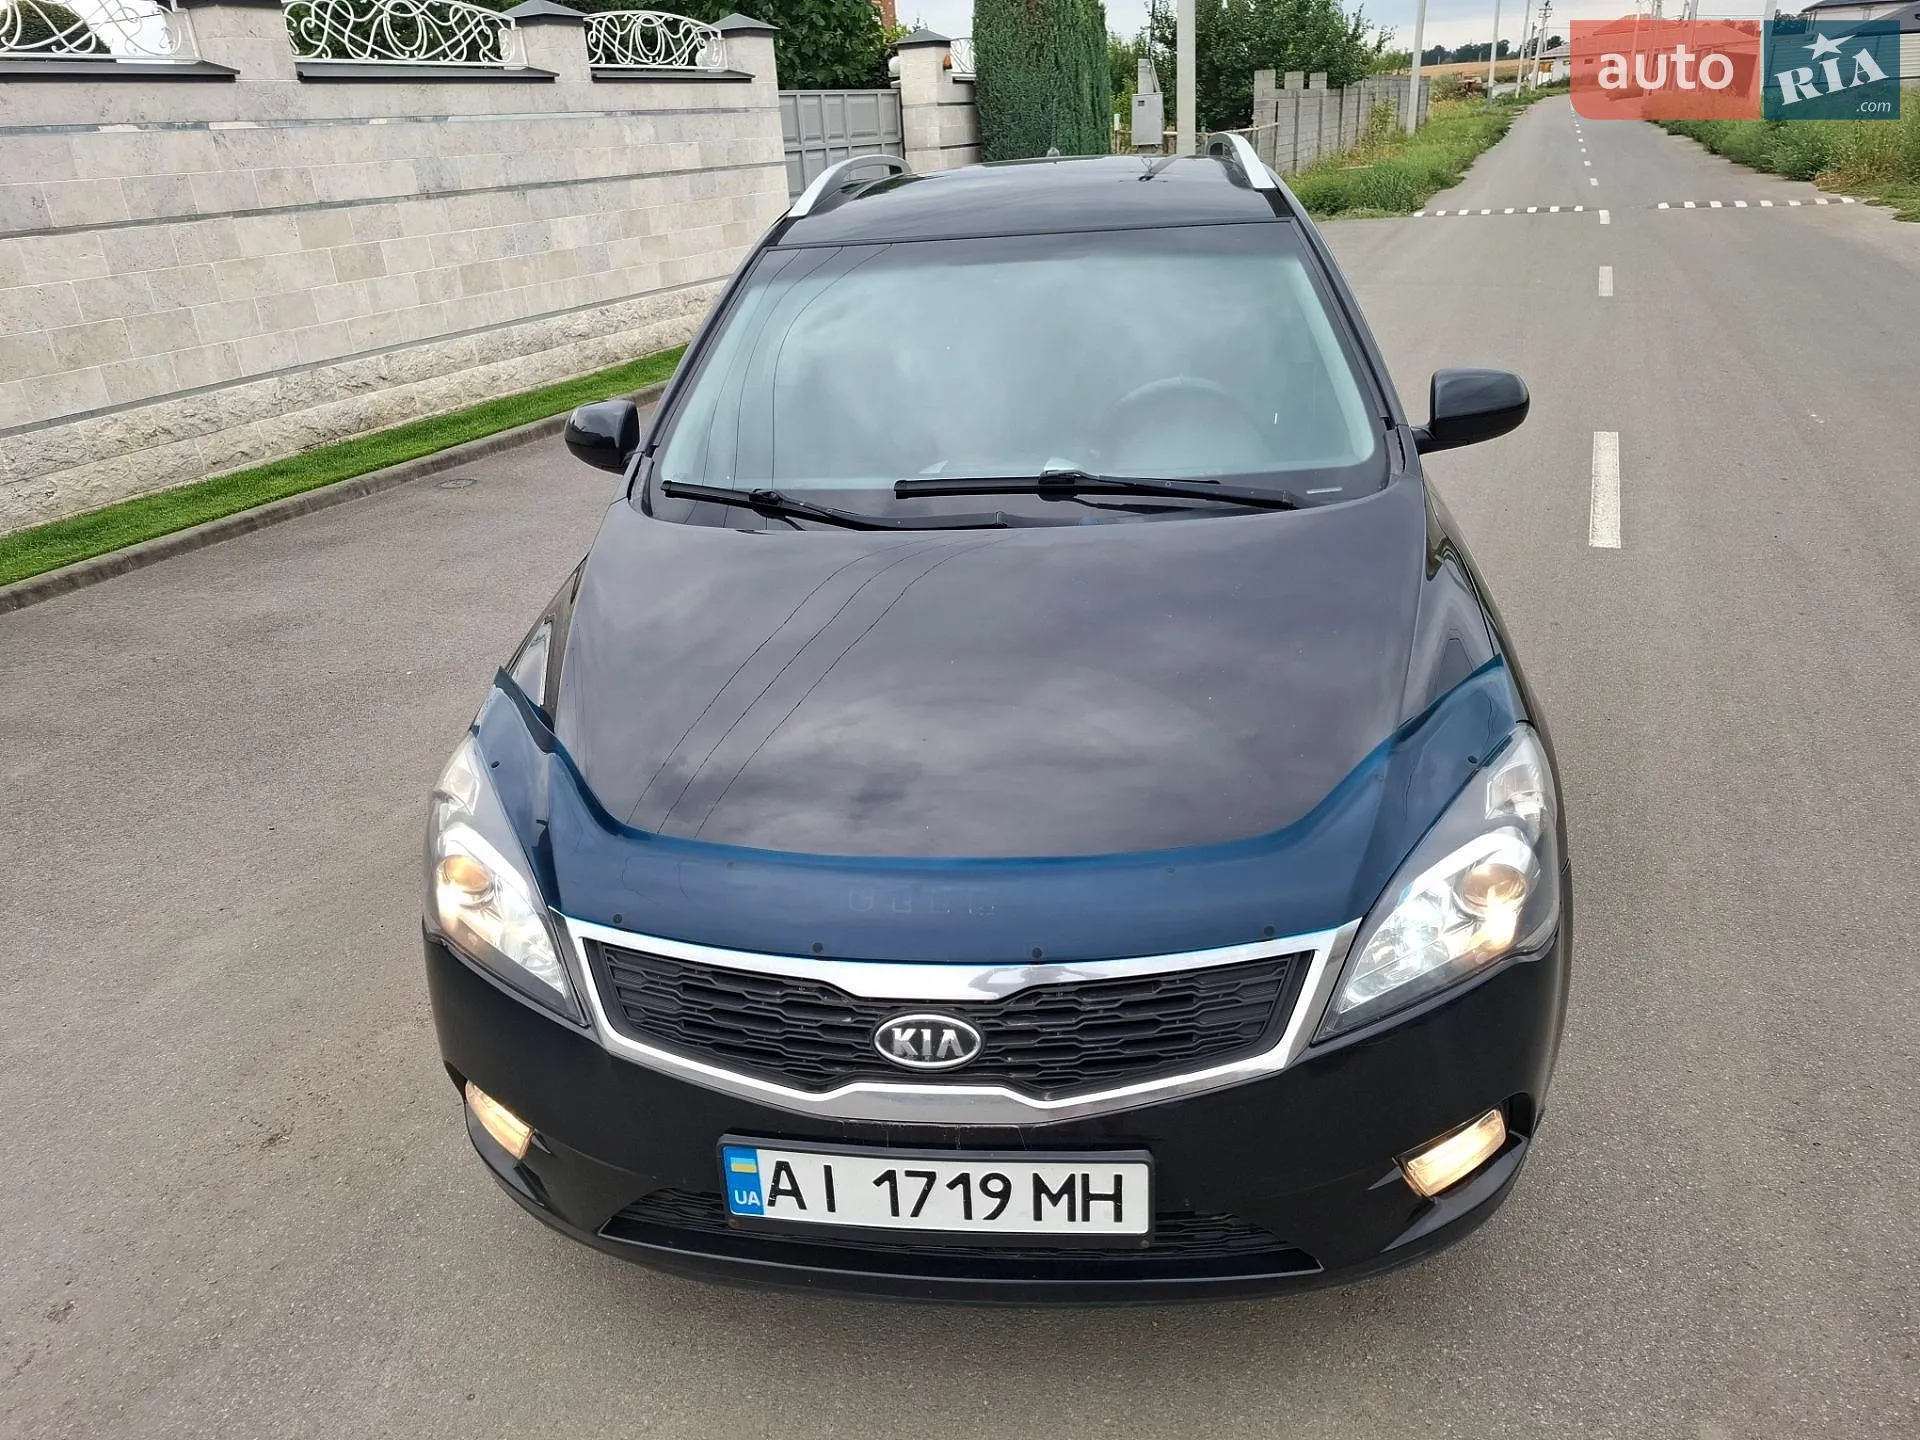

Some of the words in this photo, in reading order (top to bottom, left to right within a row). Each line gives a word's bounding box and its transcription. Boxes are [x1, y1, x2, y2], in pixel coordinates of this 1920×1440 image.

[891, 1027, 964, 1058] KIA
[735, 1191, 760, 1206] UA
[767, 1160, 836, 1212] AI
[872, 1169, 1012, 1220] 1719
[1033, 1173, 1122, 1222] MH
